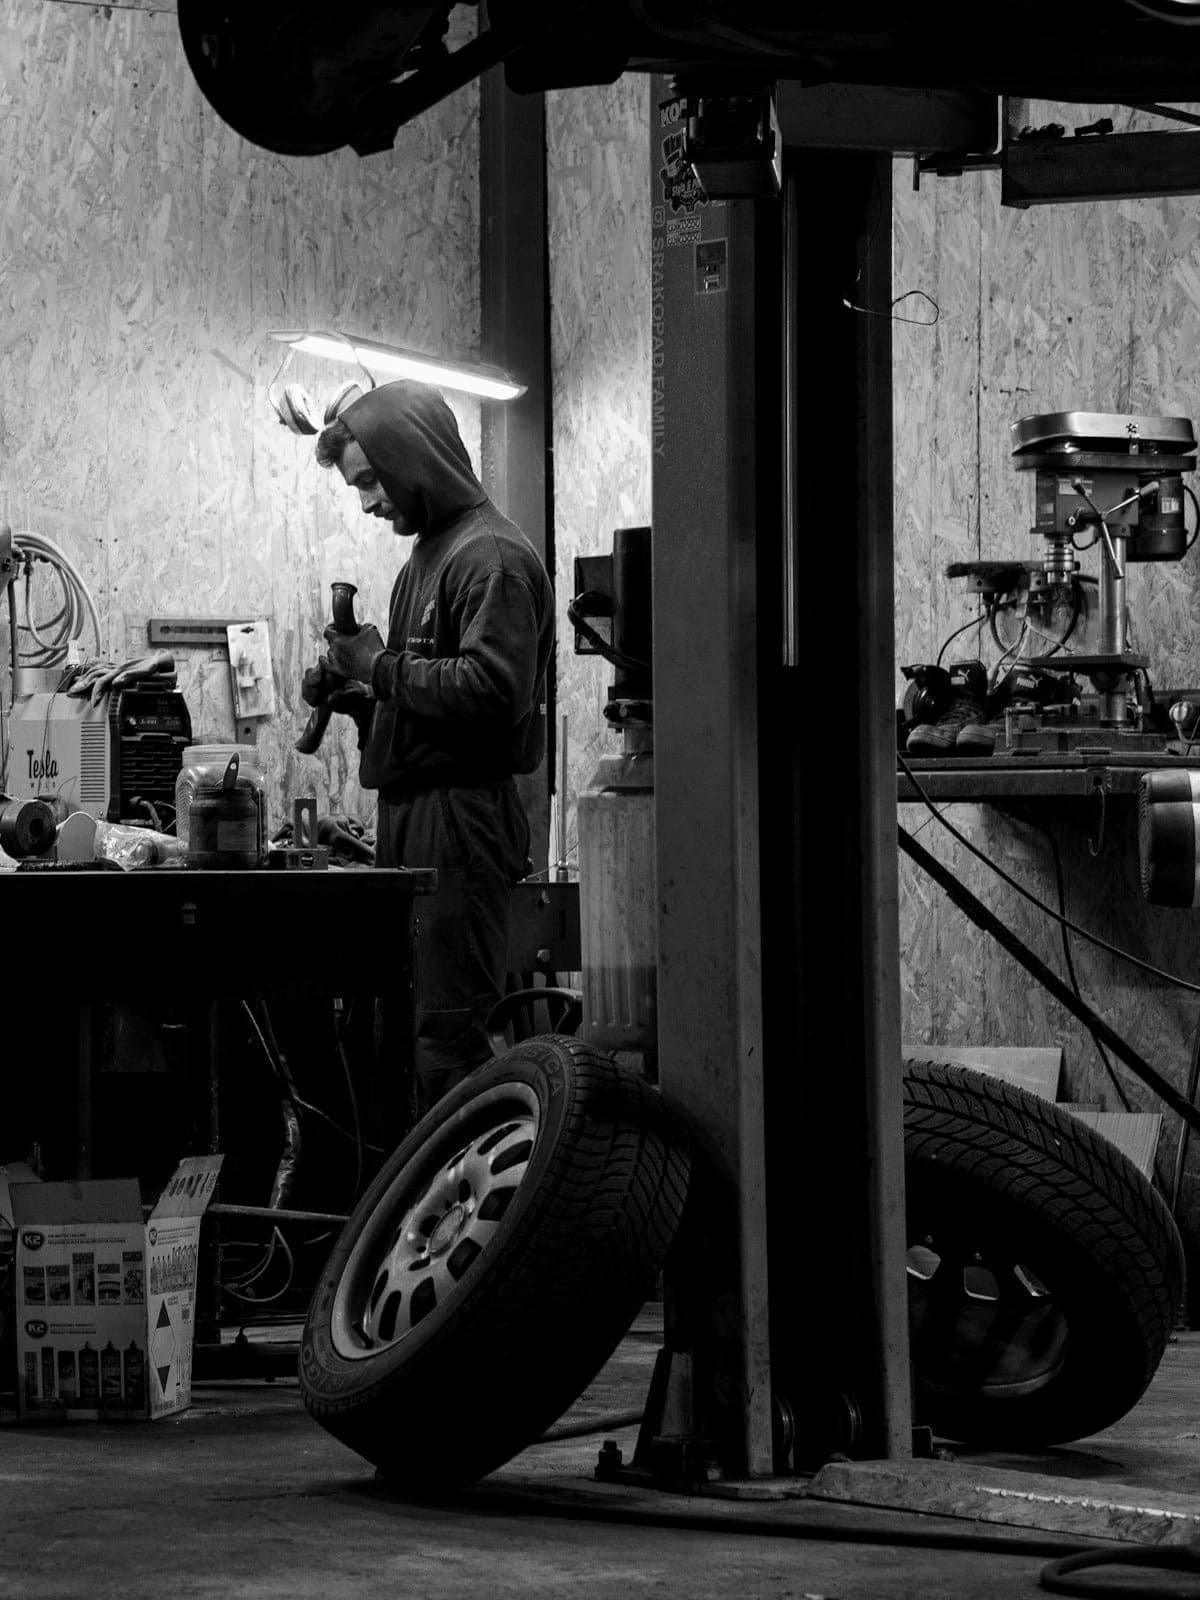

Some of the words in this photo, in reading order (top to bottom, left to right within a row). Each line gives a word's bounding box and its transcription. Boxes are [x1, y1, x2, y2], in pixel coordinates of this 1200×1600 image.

[27, 749, 59, 779] Tesla
[24, 1234, 41, 1246] K2
[28, 1322, 45, 1333] K2
